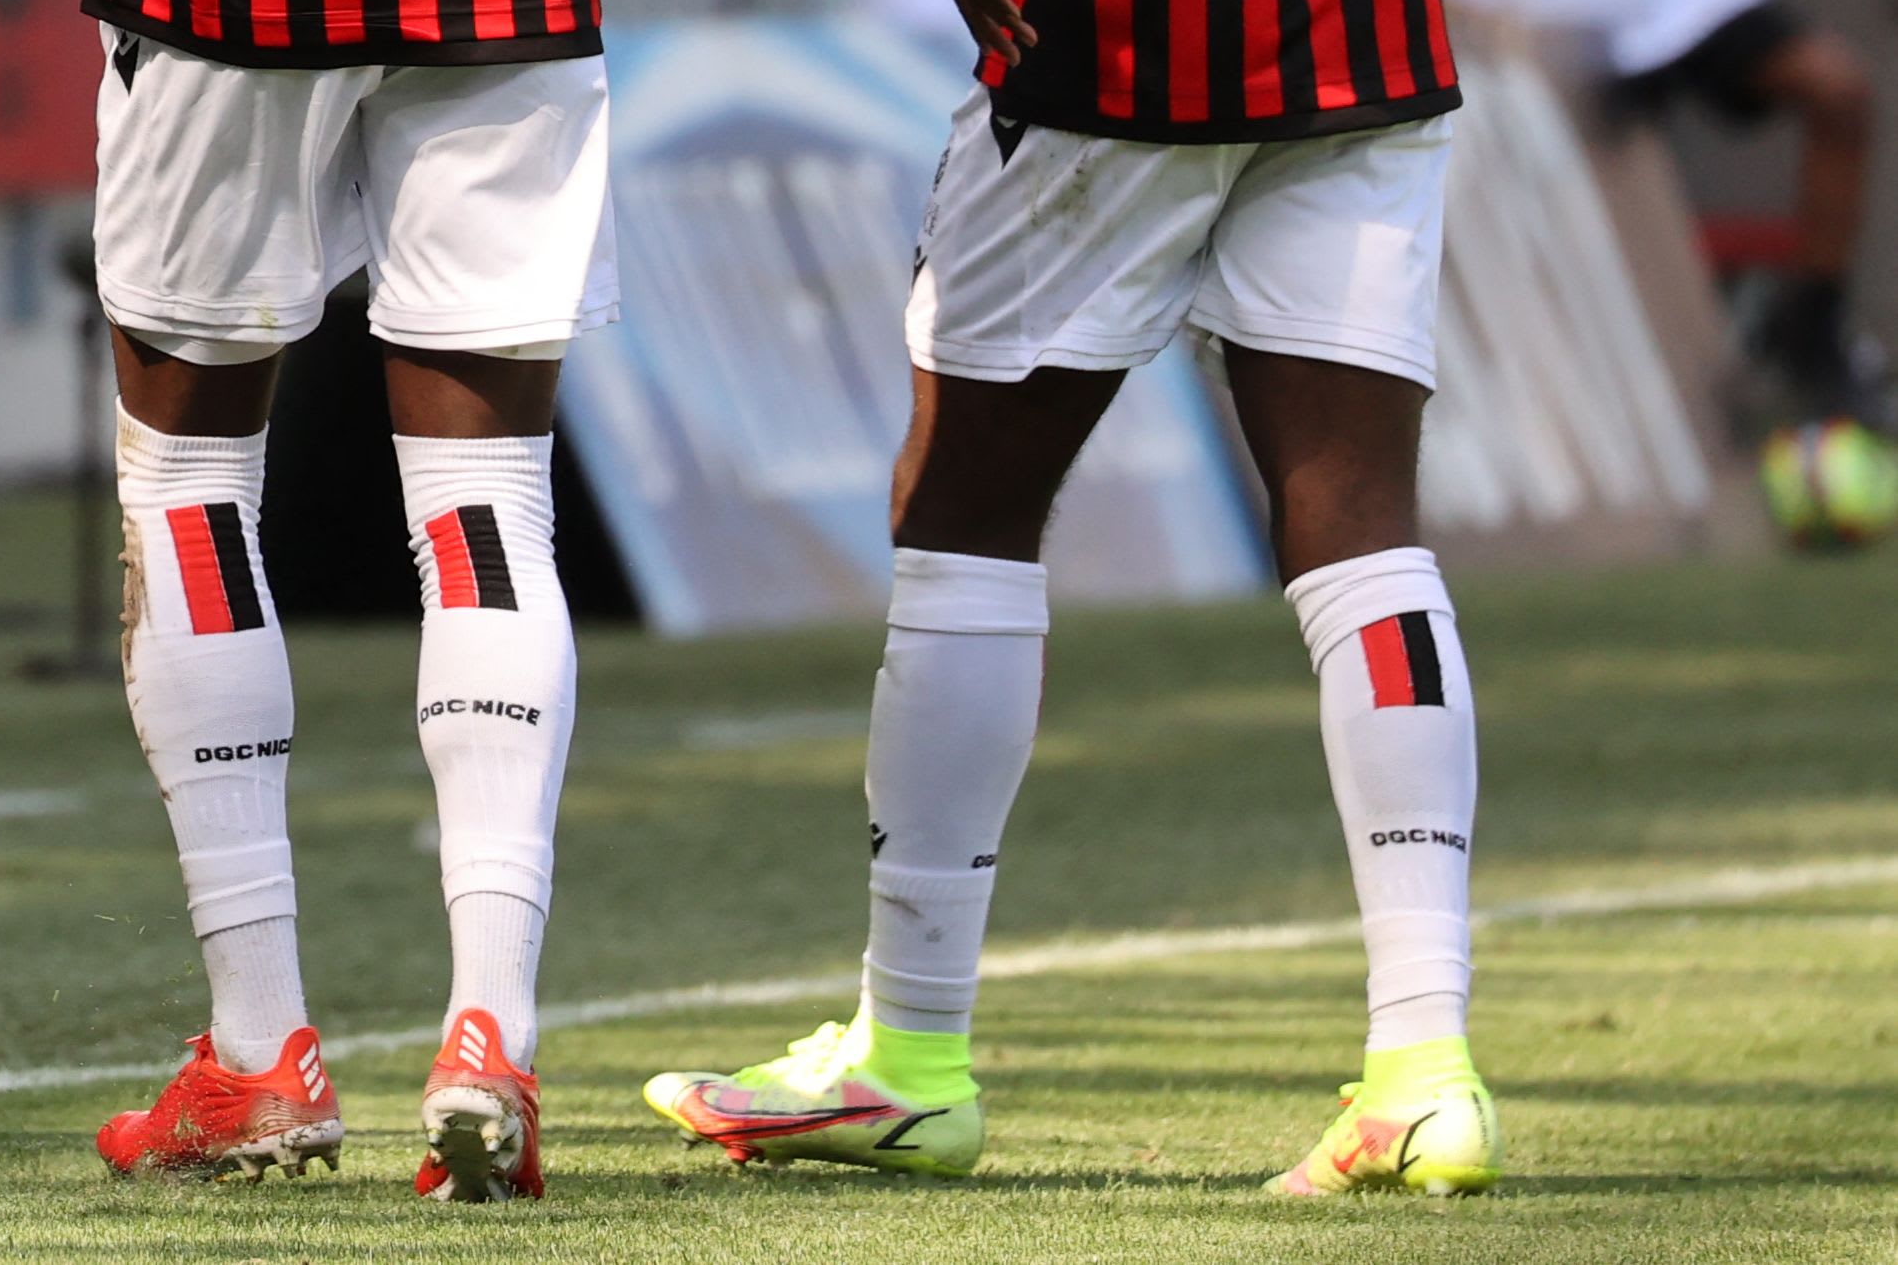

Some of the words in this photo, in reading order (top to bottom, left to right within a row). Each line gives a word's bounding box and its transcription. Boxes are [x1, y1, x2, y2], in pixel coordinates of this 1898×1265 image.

[420, 699, 466, 724] OGC
[472, 700, 541, 726] NICE
[195, 745, 253, 763] OGC
[1370, 829, 1427, 846] OGC
